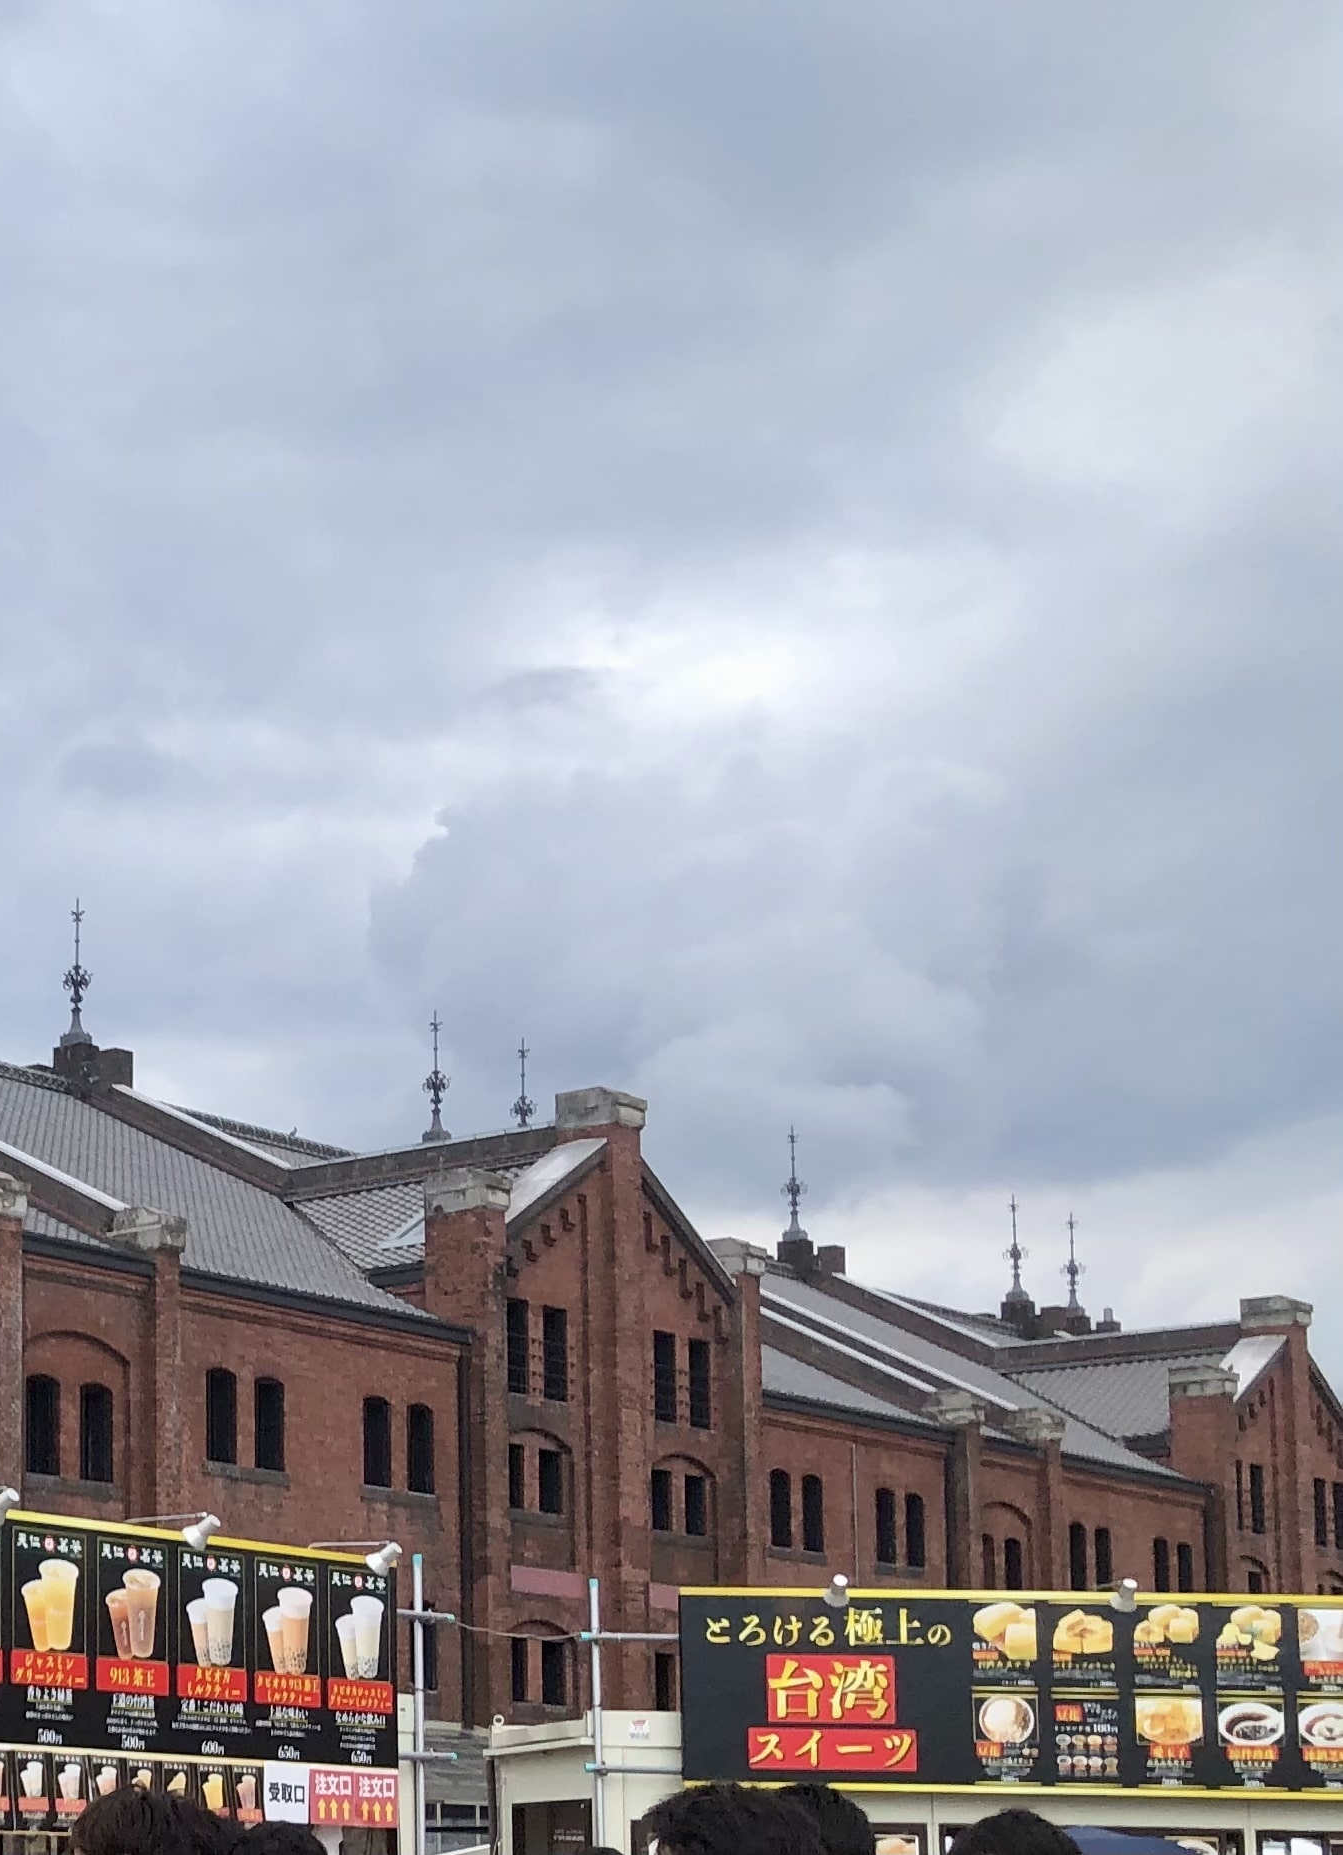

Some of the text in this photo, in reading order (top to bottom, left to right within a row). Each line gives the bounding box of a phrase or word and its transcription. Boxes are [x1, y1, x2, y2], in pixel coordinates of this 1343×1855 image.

[705, 1606, 951, 1647] とろける極上の
[25, 1653, 75, 1670] ジャスミン
[16, 1667, 85, 1687] グリーンティー
[110, 1666, 130, 1685] 913
[196, 1666, 231, 1684] タピオカ
[187, 1681, 241, 1698] ミルクティー
[768, 1659, 889, 1719] 台湾
[37, 1728, 63, 1744] 500円
[121, 1734, 146, 1750] 500円
[201, 1739, 225, 1756] 600円
[749, 1730, 913, 1767] スイーツ
[268, 1782, 305, 1804] 受取口
[315, 1773, 353, 1796] 注文口
[359, 1775, 395, 1798] 注文口
